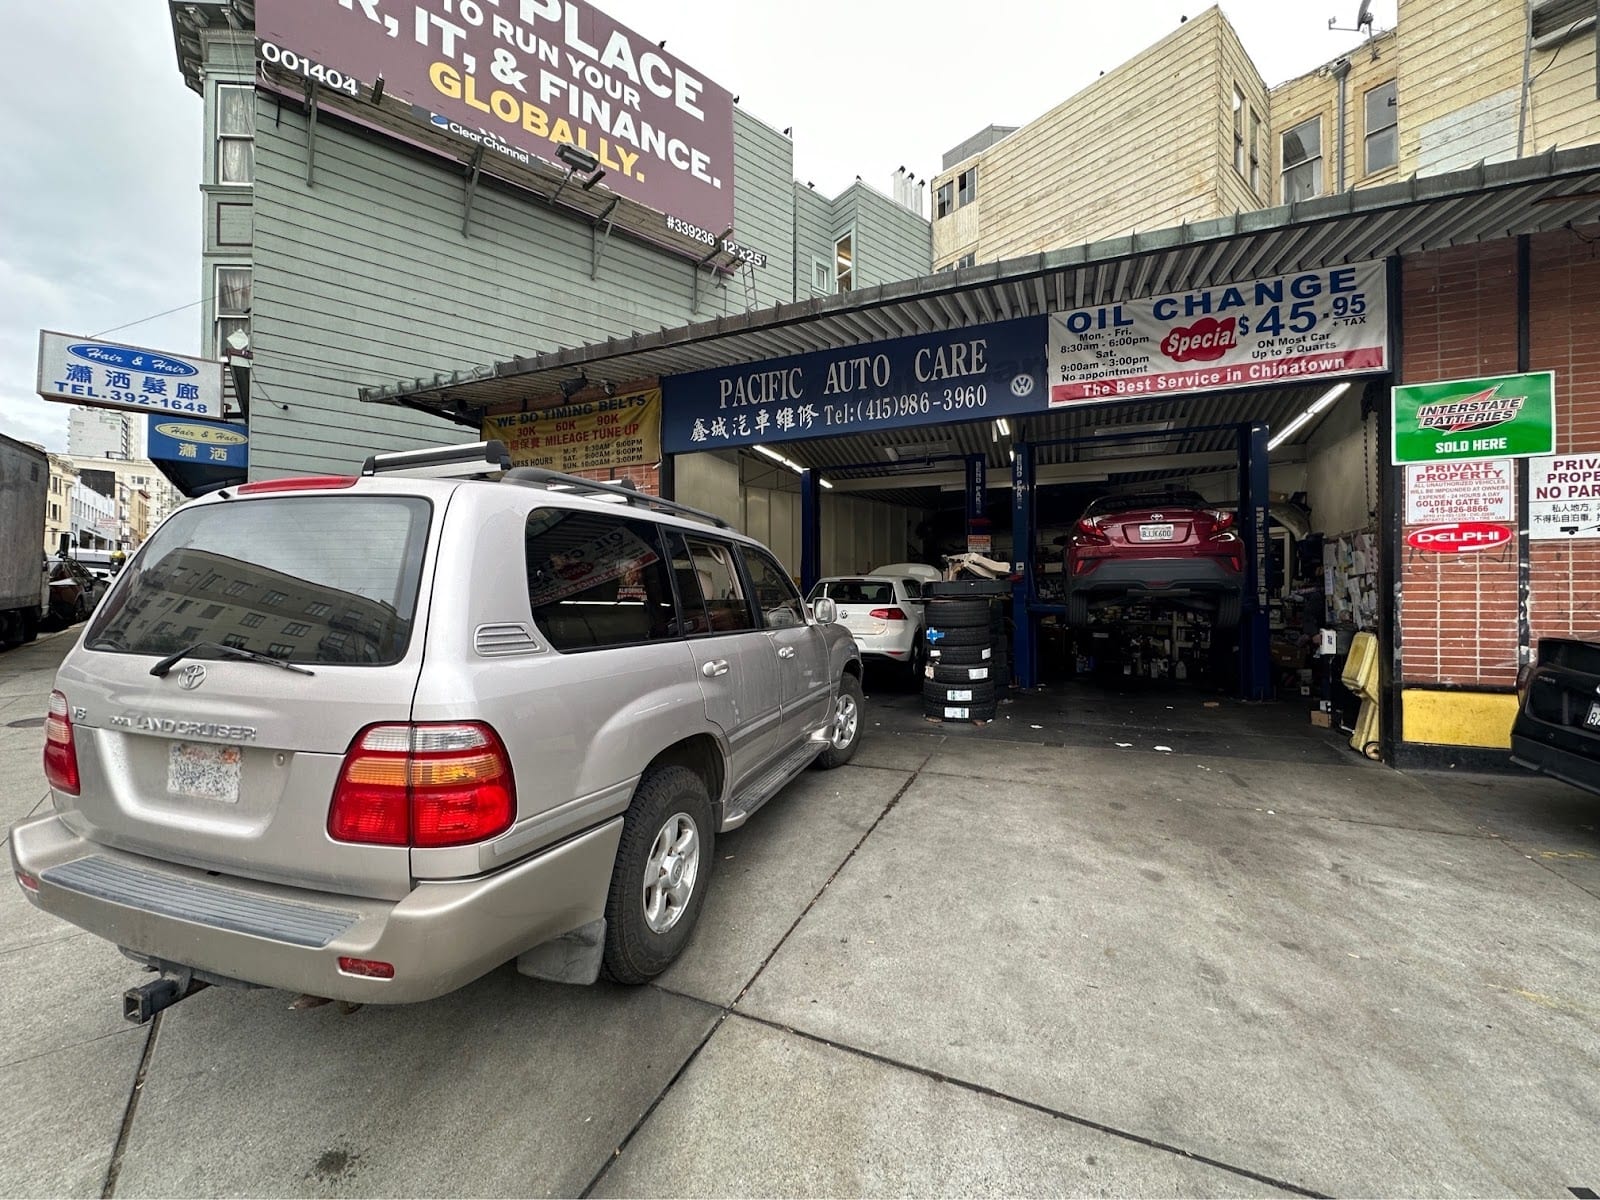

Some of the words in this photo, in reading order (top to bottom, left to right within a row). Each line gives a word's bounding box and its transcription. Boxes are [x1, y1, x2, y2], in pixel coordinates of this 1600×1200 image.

[261, 42, 358, 96] 001404
[492, 14, 559, 68] RUN
[565, 52, 641, 112] YOUR
[415, 6, 476, 75] IT,
[490, 48, 529, 94] &
[540, 68, 721, 189] FINANCE.
[429, 62, 645, 183] GLOBALLY.
[449, 122, 483, 143] Clear
[482, 135, 530, 165] Channel
[666, 215, 716, 247] #339236
[1066, 304, 1134, 335] OIL
[1152, 267, 1358, 322] CHANGE
[1343, 315, 1367, 327] TAX
[1079, 332, 1105, 342] Mon.
[1114, 328, 1133, 338] Fri.
[1166, 326, 1238, 358] Special
[1257, 339, 1275, 349] ON
[1278, 335, 1307, 347] Most
[1310, 332, 1331, 342] Car
[1060, 341, 1099, 354] 8:30am
[1108, 335, 1150, 349] 6:00pm
[1251, 350, 1267, 361] Up
[1271, 348, 1282, 357] to
[1285, 345, 1293, 355] 5
[1296, 341, 1337, 354] Quarts
[86, 347, 124, 363] Hair
[132, 356, 144, 367] &
[152, 358, 188, 375] Hair
[1060, 360, 1099, 373] 9:00am
[1109, 355, 1150, 368] 3:00pm
[1095, 350, 1117, 360] Sat.
[719, 367, 804, 409] PACIFIC
[823, 353, 891, 395] AUTO
[914, 339, 988, 383] CARE
[1061, 373, 1077, 383] No
[1078, 364, 1150, 382] appointment
[1083, 383, 1110, 397] The
[1116, 378, 1151, 394] Best
[1157, 371, 1220, 390] Service
[1226, 368, 1242, 383] in
[1249, 355, 1345, 380] Chinatown
[53, 381, 208, 415] TEL.392-1648
[1419, 398, 1521, 416] INTERSTATE
[496, 415, 516, 428] WE
[520, 412, 539, 425] DO
[542, 403, 593, 420] TIMING
[598, 394, 647, 412] BELTS
[1423, 410, 1514, 427] BATTERIES
[170, 425, 195, 438] Hair
[200, 430, 209, 438] &
[214, 431, 242, 443] Hair
[545, 431, 589, 447] MILEAGE
[592, 426, 621, 441] TUNE
[624, 423, 639, 436] UP
[555, 420, 577, 432] 60K
[1435, 440, 1470, 454] SOLD
[1472, 437, 1508, 452] HERE
[530, 457, 553, 466] HOURS
[1425, 462, 1495, 474] PRIVATE
[1415, 470, 1504, 482] PROPERTY
[1426, 480, 1474, 488] UNAUTHORIZED
[1536, 486, 1562, 499] NO
[1568, 484, 1600, 498] PAR
[1415, 499, 1453, 508] GOLDEN
[1455, 498, 1480, 506] GATE
[1483, 497, 1504, 505] TOW
[1429, 505, 1490, 514] 415-826-8866
[1417, 531, 1500, 543] DELPHI
[136, 717, 177, 733] LAND
[176, 720, 258, 740] CRUISER
